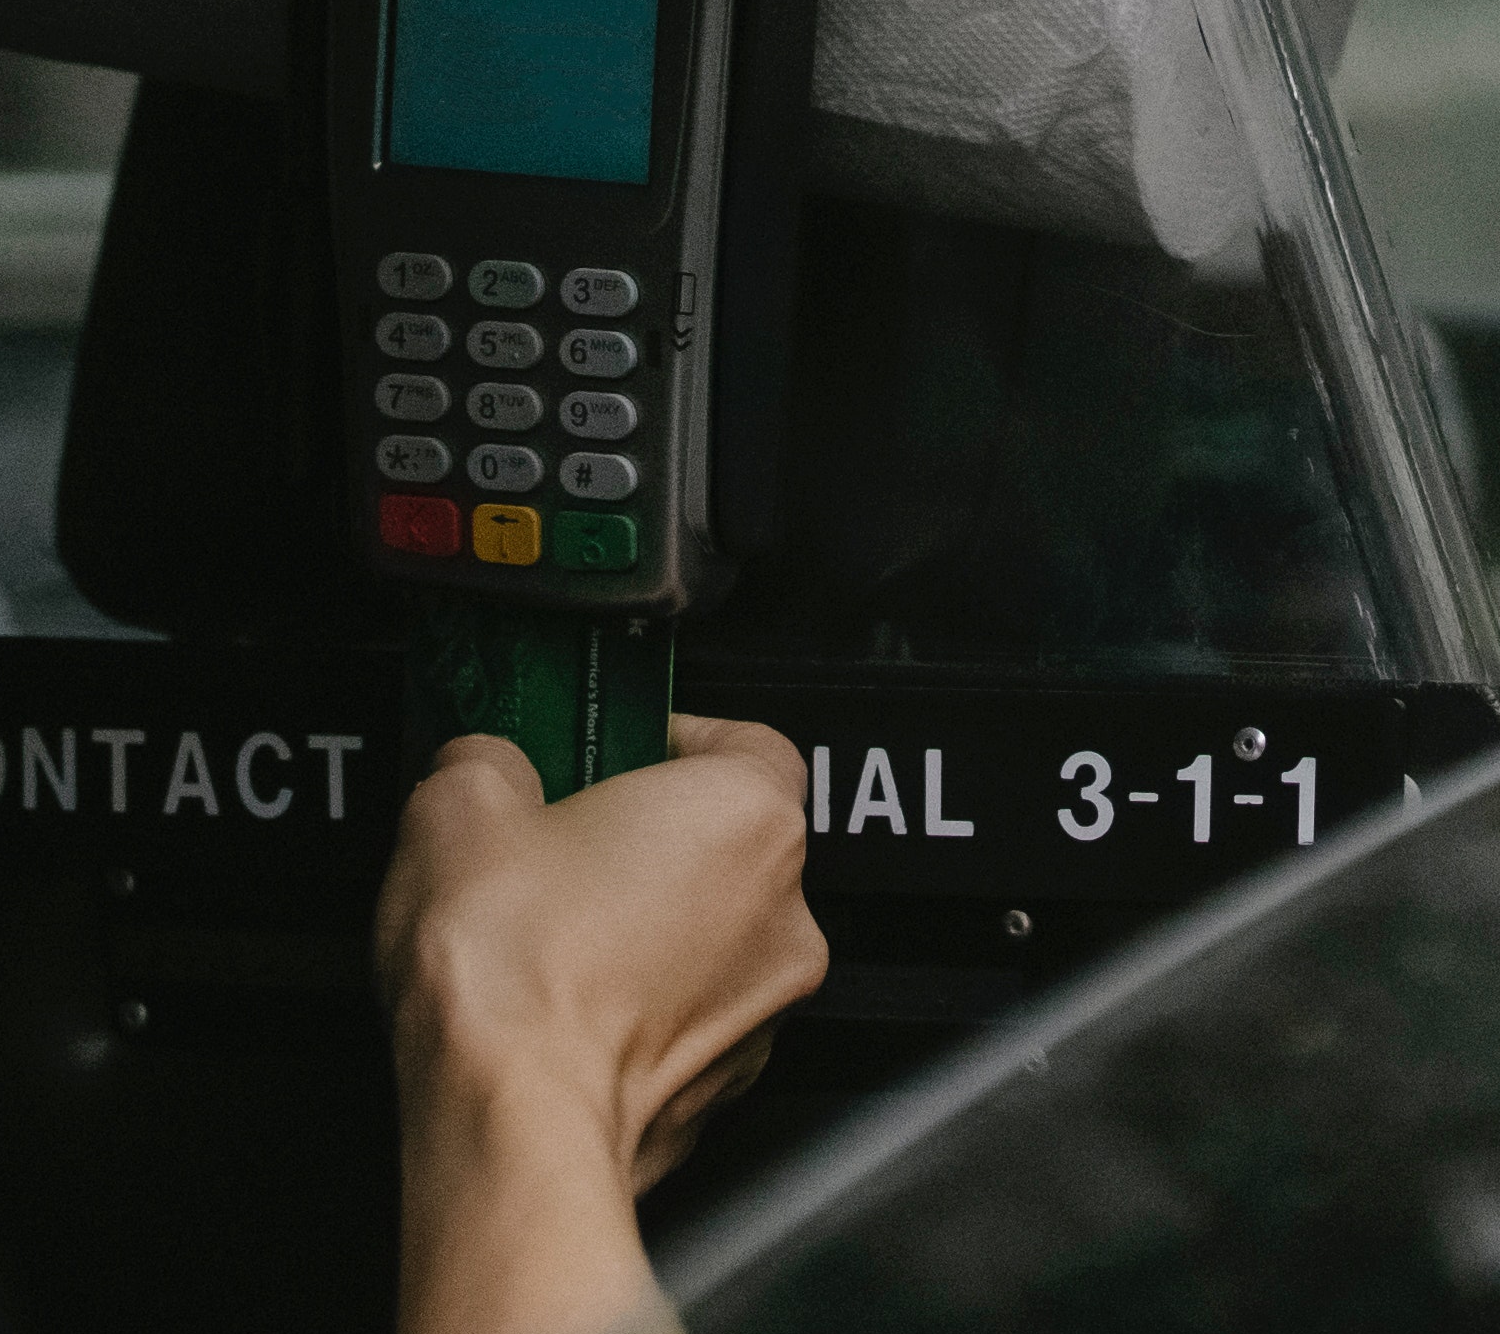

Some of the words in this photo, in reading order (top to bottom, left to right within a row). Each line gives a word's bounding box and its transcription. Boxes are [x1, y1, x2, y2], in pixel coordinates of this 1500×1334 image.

[392, 261, 406, 288] 1
[482, 269, 499, 297] 2
[501, 271, 528, 285] ABC
[573, 277, 590, 304] 3
[593, 278, 622, 293] DEF
[387, 321, 407, 350] 4
[479, 330, 497, 357] 5
[500, 331, 525, 346] JKL
[570, 338, 587, 364] 6
[589, 338, 623, 353] MNO
[388, 383, 404, 409] 7
[479, 392, 496, 419] 8
[499, 393, 526, 407] TUV
[570, 401, 588, 428] 9
[480, 454, 499, 480] 0
[585, 703, 599, 742] Most
[812, 745, 975, 838] IAL
[1056, 750, 1317, 846] 3-1-1
